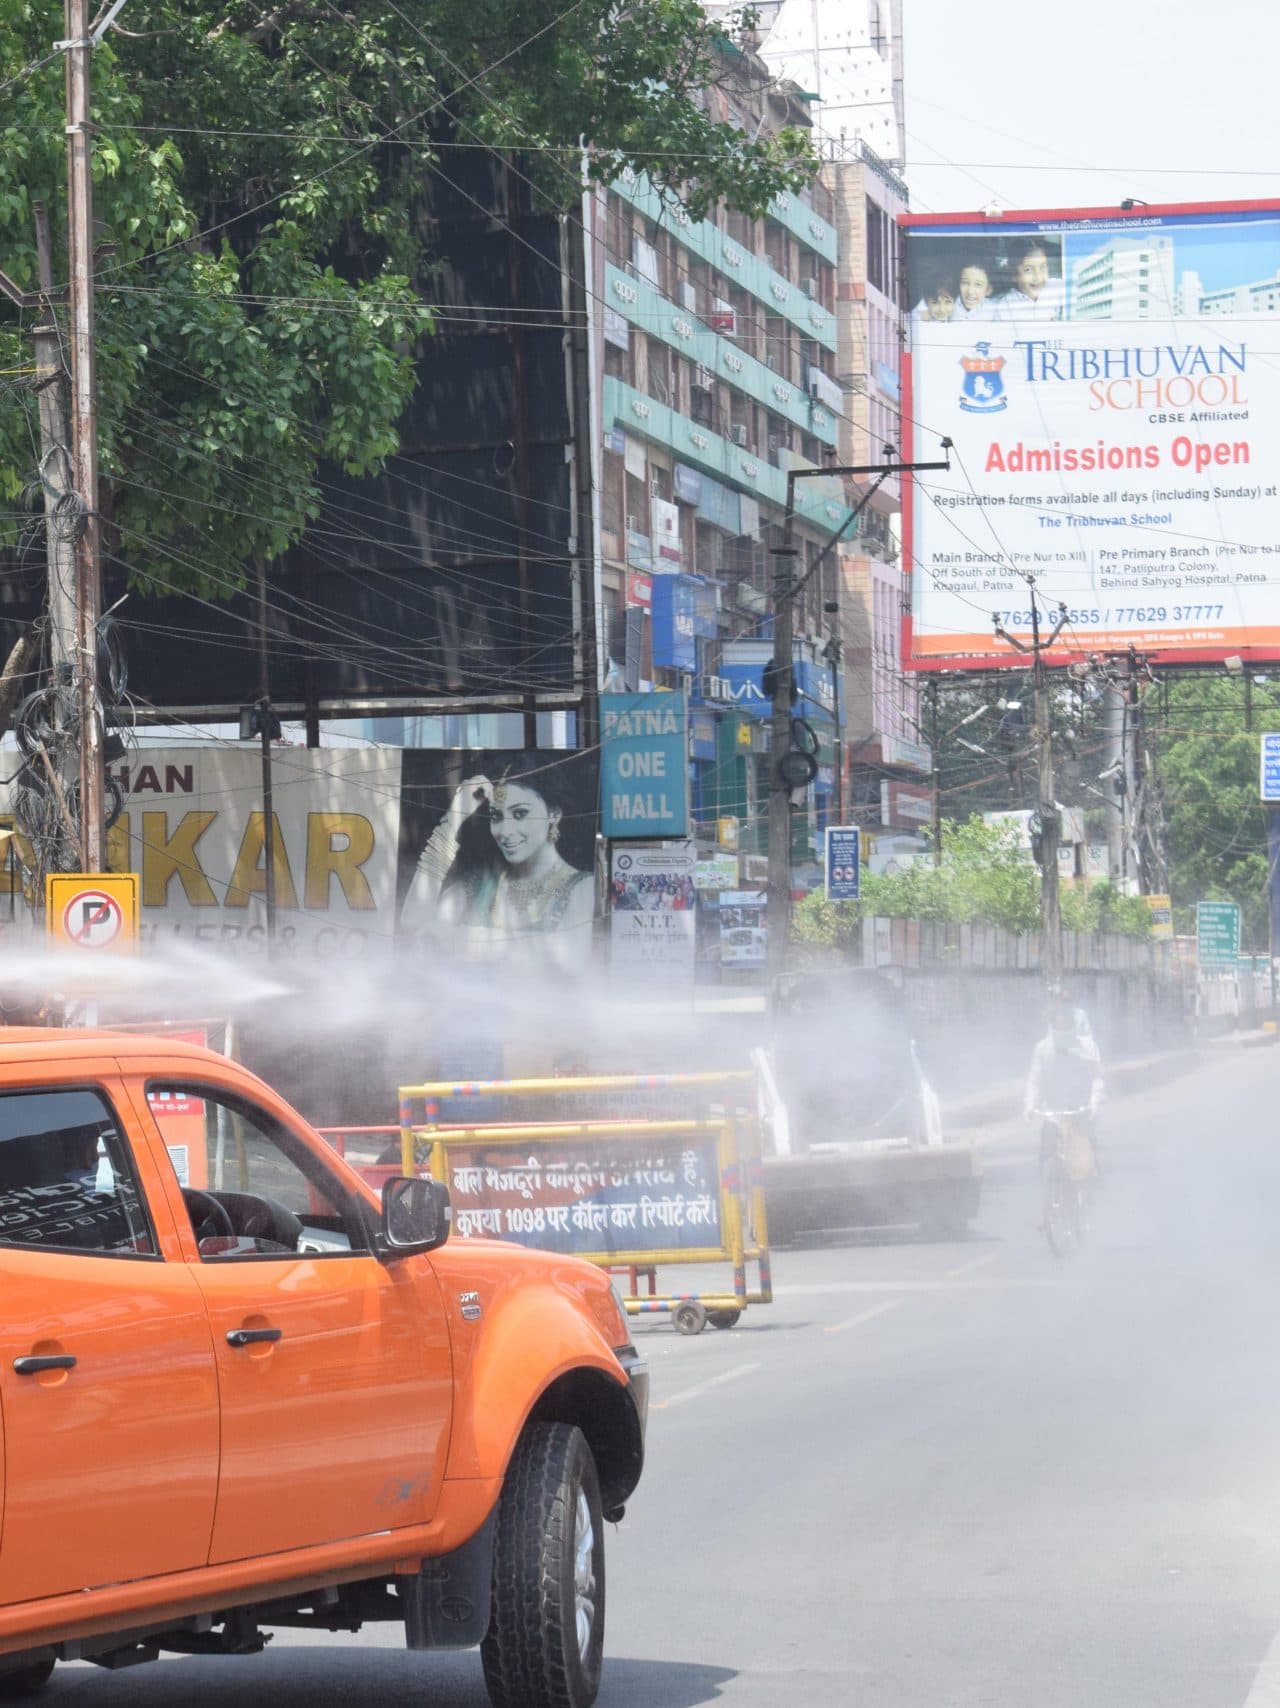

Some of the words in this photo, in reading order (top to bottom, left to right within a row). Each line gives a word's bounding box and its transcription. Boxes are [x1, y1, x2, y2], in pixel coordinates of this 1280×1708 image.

[1014, 341, 1247, 381] TRIBHUVAN
[1089, 375, 1248, 411] SCHOOL
[1149, 412, 1185, 424] CBSE
[1190, 410, 1249, 423] Affiliated
[985, 440, 1160, 473] Admissions
[1171, 436, 1250, 473] Open
[933, 494, 1006, 508] Registration
[1009, 494, 1043, 505] forms
[1046, 492, 1099, 504] available
[1103, 491, 1117, 503] all
[1121, 490, 1148, 504] days
[1152, 489, 1210, 503] (including
[1213, 486, 1261, 499] Sunday)
[1265, 485, 1277, 496] at
[1039, 516, 1061, 528] The
[1066, 514, 1127, 528] Tribhuvan
[1130, 512, 1173, 525] School
[932, 552, 961, 564] Main
[965, 552, 1005, 563] Branch
[1033, 552, 1052, 562] Nur
[1056, 552, 1066, 562] to
[1099, 549, 1118, 560] Pre
[1122, 548, 1167, 561] Primary
[1170, 547, 1210, 558] Branch
[951, 567, 982, 578] South
[986, 567, 997, 578] of
[1101, 577, 1139, 589] Behind
[1142, 575, 1181, 589] Sahyog
[1236, 572, 1268, 583] Patna
[1124, 564, 1175, 576] Patliputra
[983, 580, 1014, 591] Patna
[1116, 606, 1167, 623] 77629
[1173, 604, 1224, 620] 37777
[604, 709, 678, 737] PATNA
[617, 751, 666, 778] ONE
[611, 793, 673, 820] MALL
[453, 1166, 483, 1196] बाल
[505, 1208, 545, 1234] 1098
[546, 1205, 572, 1233] पर
[571, 1199, 609, 1234] कॉल
[609, 1202, 638, 1230] कर
